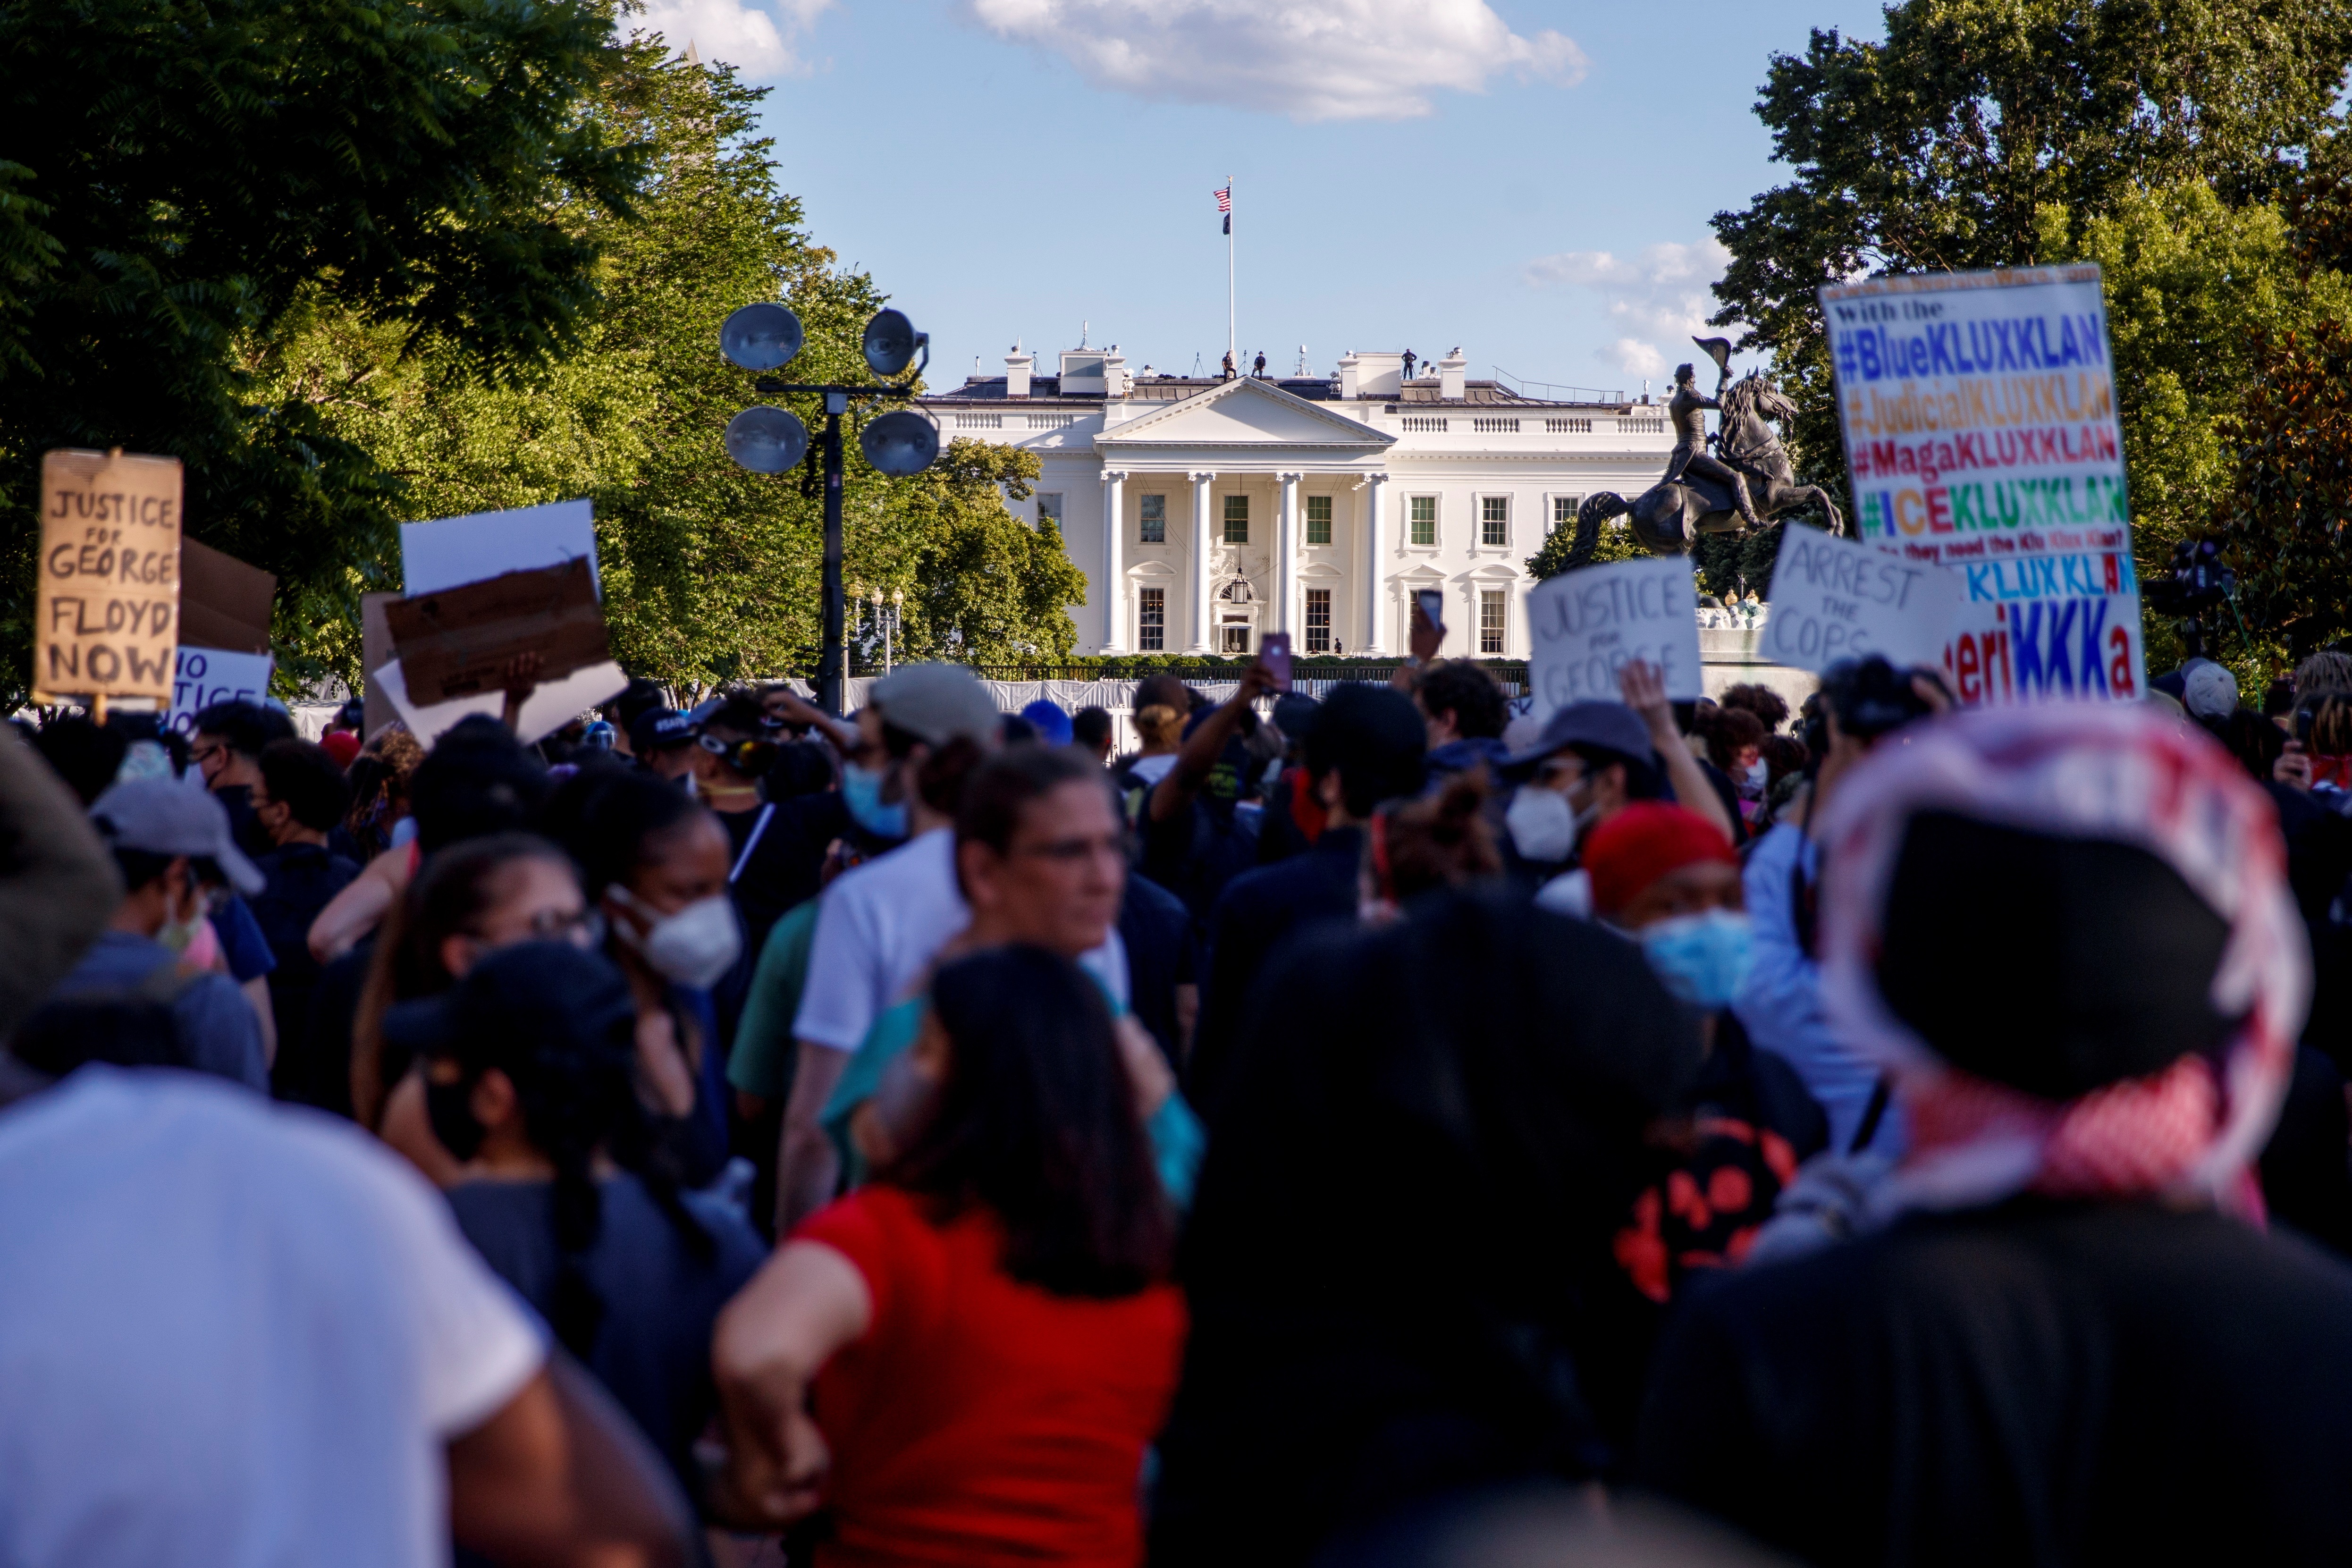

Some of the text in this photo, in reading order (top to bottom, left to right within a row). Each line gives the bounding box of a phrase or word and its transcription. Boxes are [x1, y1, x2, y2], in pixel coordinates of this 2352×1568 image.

[1901, 299, 1947, 319] the
[1838, 312, 2105, 384] #BlueKLUXKLAN
[1847, 371, 2113, 438] #JudicialKLUXKLAN
[1852, 424, 2117, 485] #MagaKLUXKLAN
[51, 490, 174, 529] JUSTICE
[1861, 476, 2127, 538] #ICEKLUXKLAN
[49, 543, 173, 585] GEORGE
[86, 527, 122, 546] FOR
[1784, 539, 1922, 610] ARREST
[51, 597, 171, 637] FLOYD
[1540, 574, 1682, 644] JUSTICE
[1773, 606, 1870, 662] COPS
[1821, 595, 1858, 621] THE
[49, 642, 171, 686] NOW
[1944, 599, 2135, 703] eriKKKa
